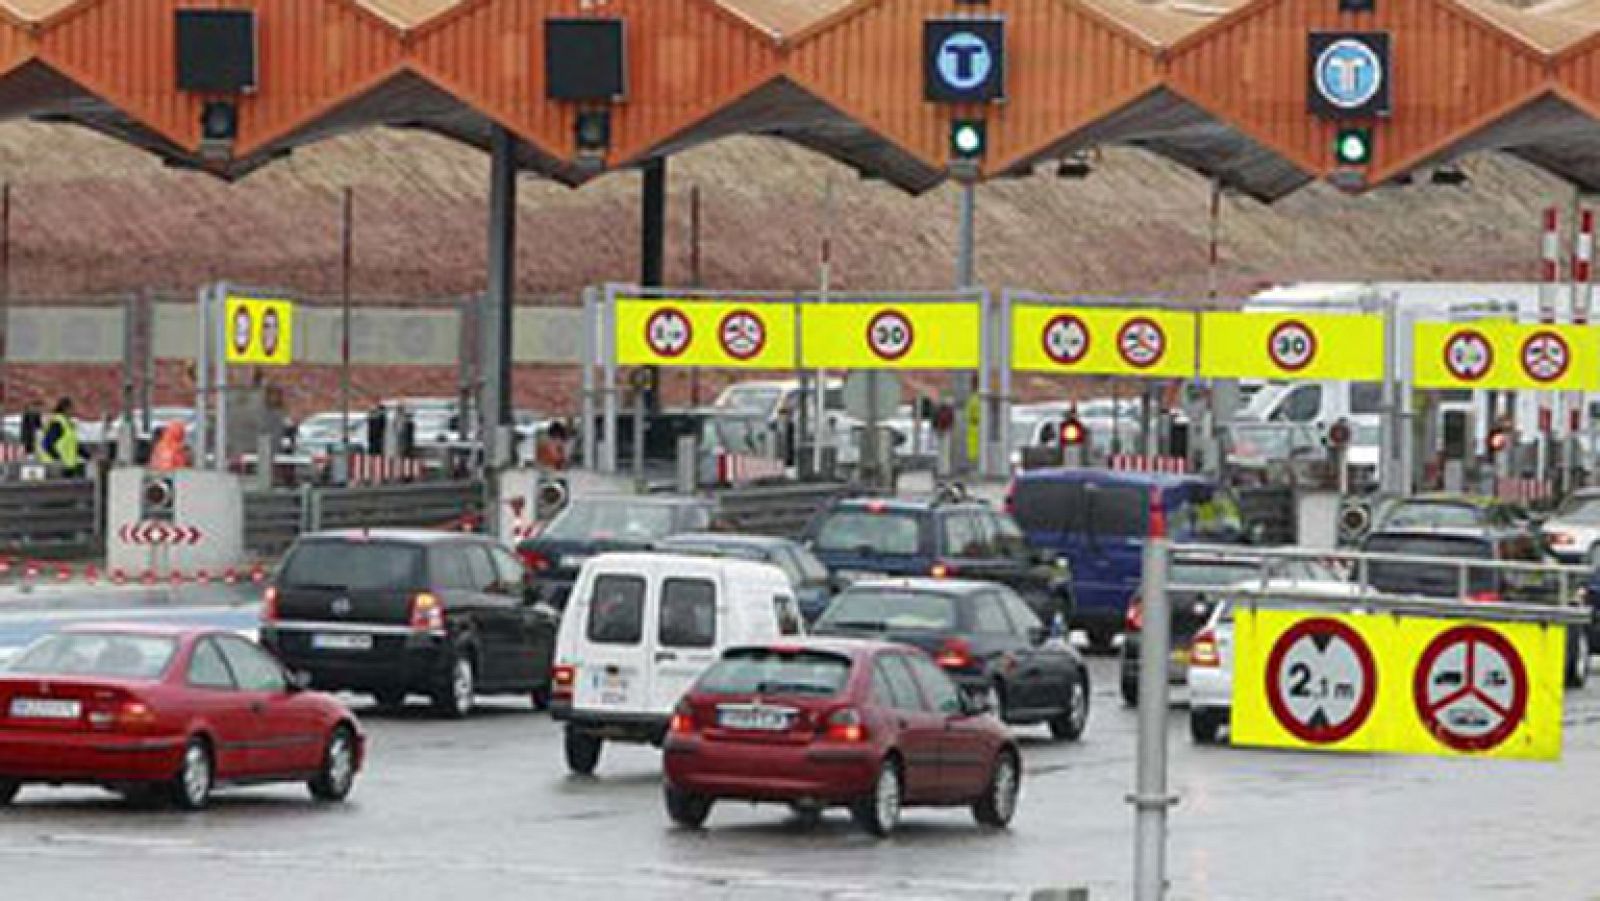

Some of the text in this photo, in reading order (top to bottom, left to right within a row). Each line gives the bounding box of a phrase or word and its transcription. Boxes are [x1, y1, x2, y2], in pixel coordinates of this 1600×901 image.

[945, 45, 982, 80] T
[1330, 57, 1366, 92] T
[877, 325, 905, 345] 30
[1278, 335, 1306, 356] 30
[1334, 683, 1354, 700] m
